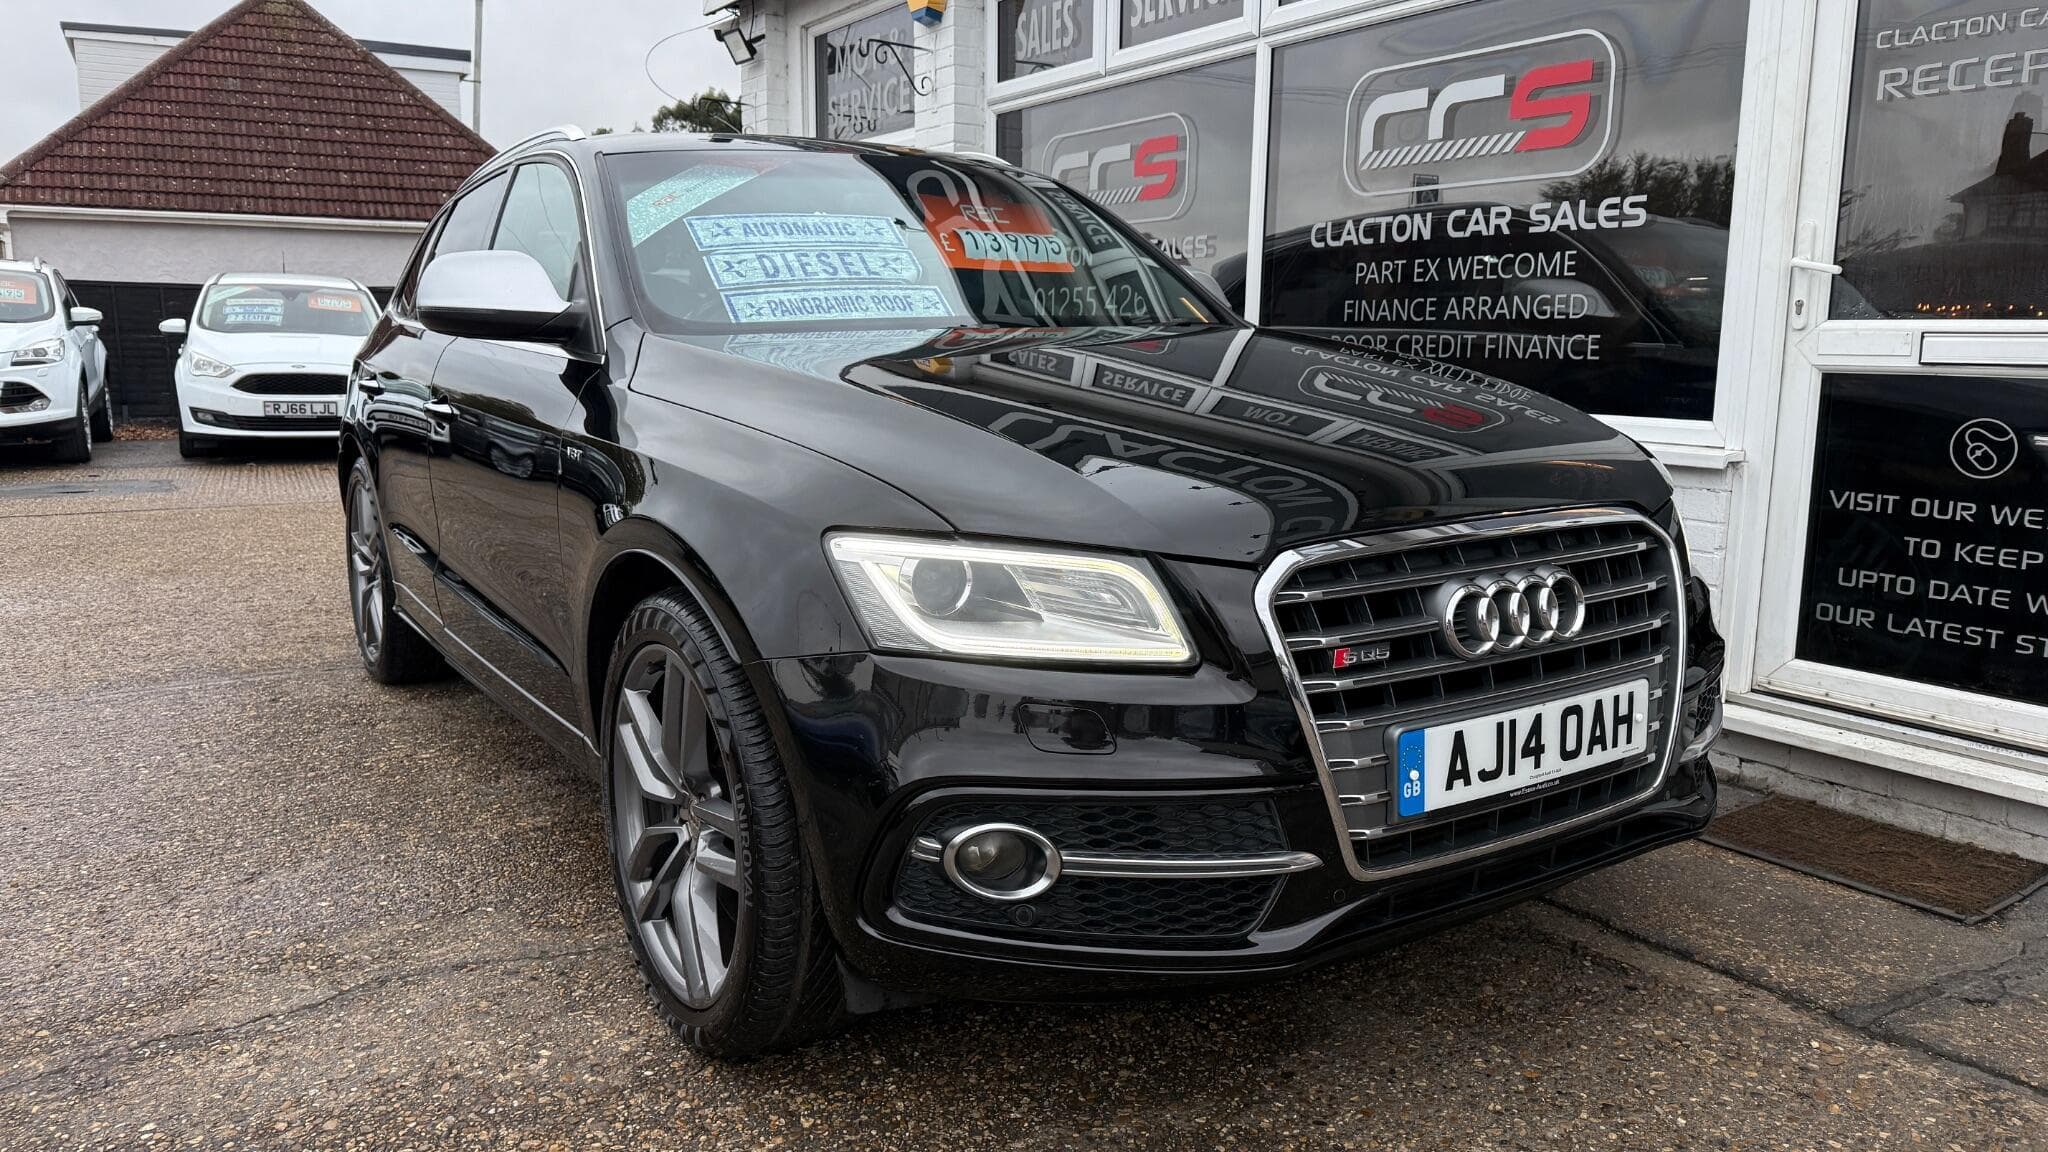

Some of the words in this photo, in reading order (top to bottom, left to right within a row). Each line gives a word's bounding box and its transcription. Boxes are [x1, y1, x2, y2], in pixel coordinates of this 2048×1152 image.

[1016, 0, 1074, 60] SALES
[1876, 12, 2007, 49] CLACTON
[828, 76, 912, 130] SERVICE
[1359, 59, 1594, 167] CCS
[743, 220, 857, 238] AUTOMATIC
[1310, 212, 1433, 249] CLACTON
[1446, 206, 1511, 238] CAR
[1528, 194, 1647, 233] SALES
[965, 231, 1062, 256] 13995
[1150, 235, 1208, 259] ALES
[755, 252, 881, 279] DIESEL
[1355, 259, 1406, 285] PART
[1413, 256, 1441, 283] EX
[1447, 250, 1578, 281] WELCOME
[767, 296, 870, 318] PANORAMIC
[873, 295, 914, 313] ROOF
[1343, 297, 1438, 322] FINANCE
[1443, 293, 1589, 321] ARRANGED
[1395, 334, 1481, 359] CREDIT
[1486, 333, 1600, 360] FINANCE
[273, 403, 307, 415] RJ66
[310, 403, 335, 415] LJL
[1829, 489, 1900, 514] VISIT
[1910, 498, 1977, 522] OUR
[1991, 504, 2048, 529] WE
[1903, 536, 1941, 559] TO
[1954, 543, 2044, 570] KEEP
[1838, 567, 1916, 595] UPTO
[1928, 580, 2012, 609] DATE
[1815, 602, 1876, 629] OUR
[1887, 613, 2004, 649] LATEST
[1445, 712, 1546, 792] AJ14
[1560, 691, 1635, 762] OAH
[1404, 781, 1421, 798] GB
[735, 783, 753, 907] UNIROYAL
